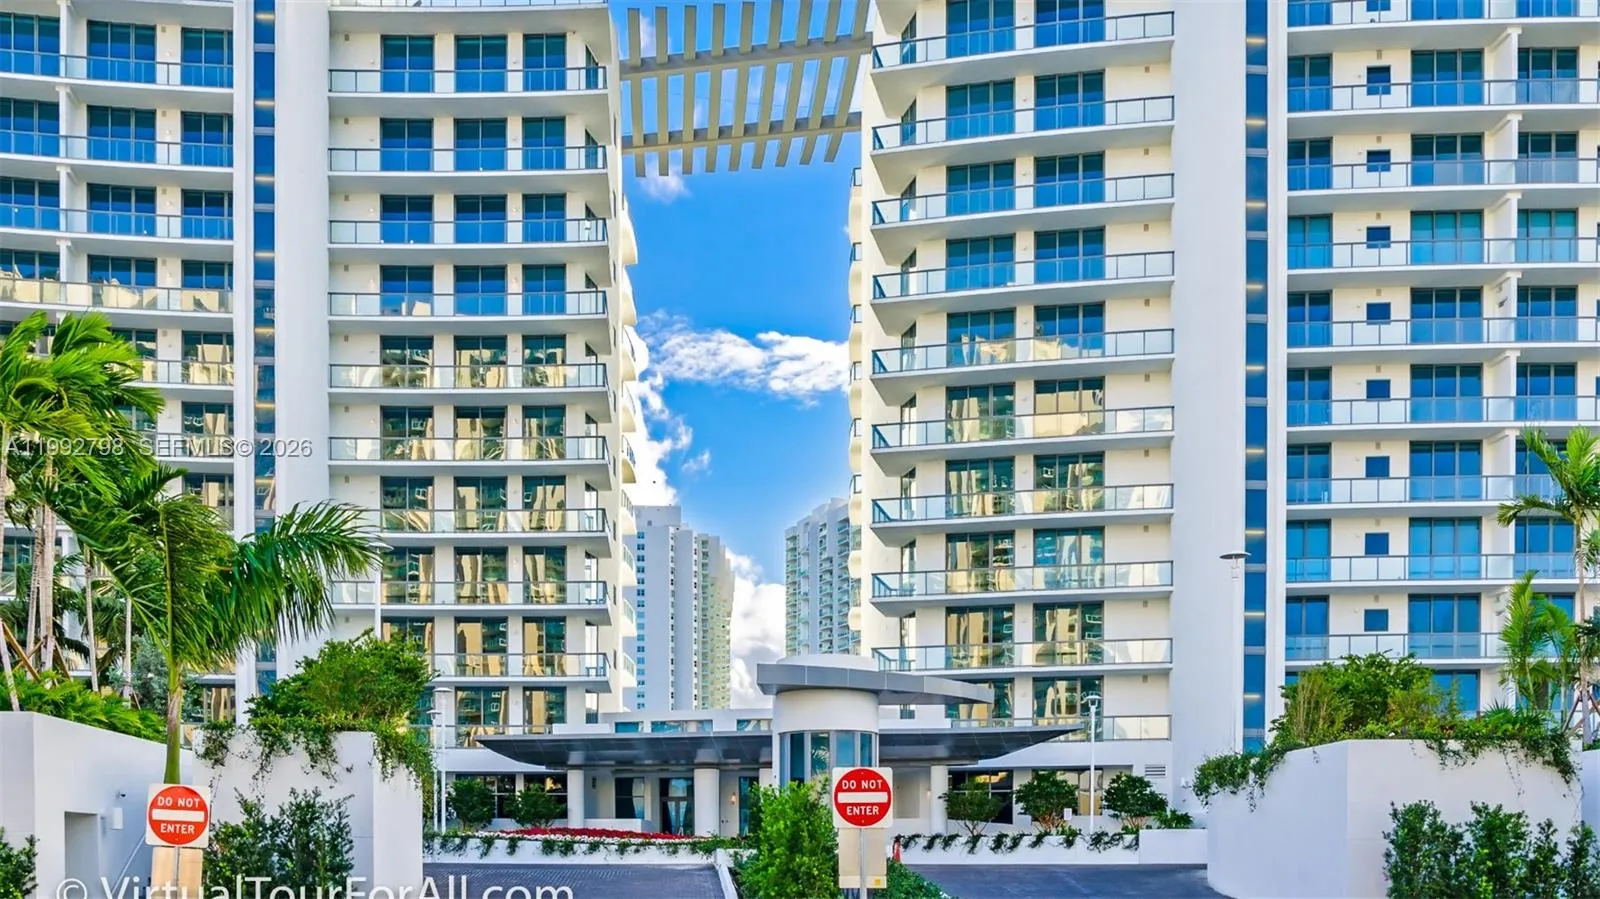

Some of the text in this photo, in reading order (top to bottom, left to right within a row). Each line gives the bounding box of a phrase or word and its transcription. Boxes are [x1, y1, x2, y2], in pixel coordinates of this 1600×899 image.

[842, 779, 883, 790] DO NOT
[157, 796, 201, 808] DO NOT
[846, 805, 880, 816] ENTER
[160, 823, 196, 834] ENTER
